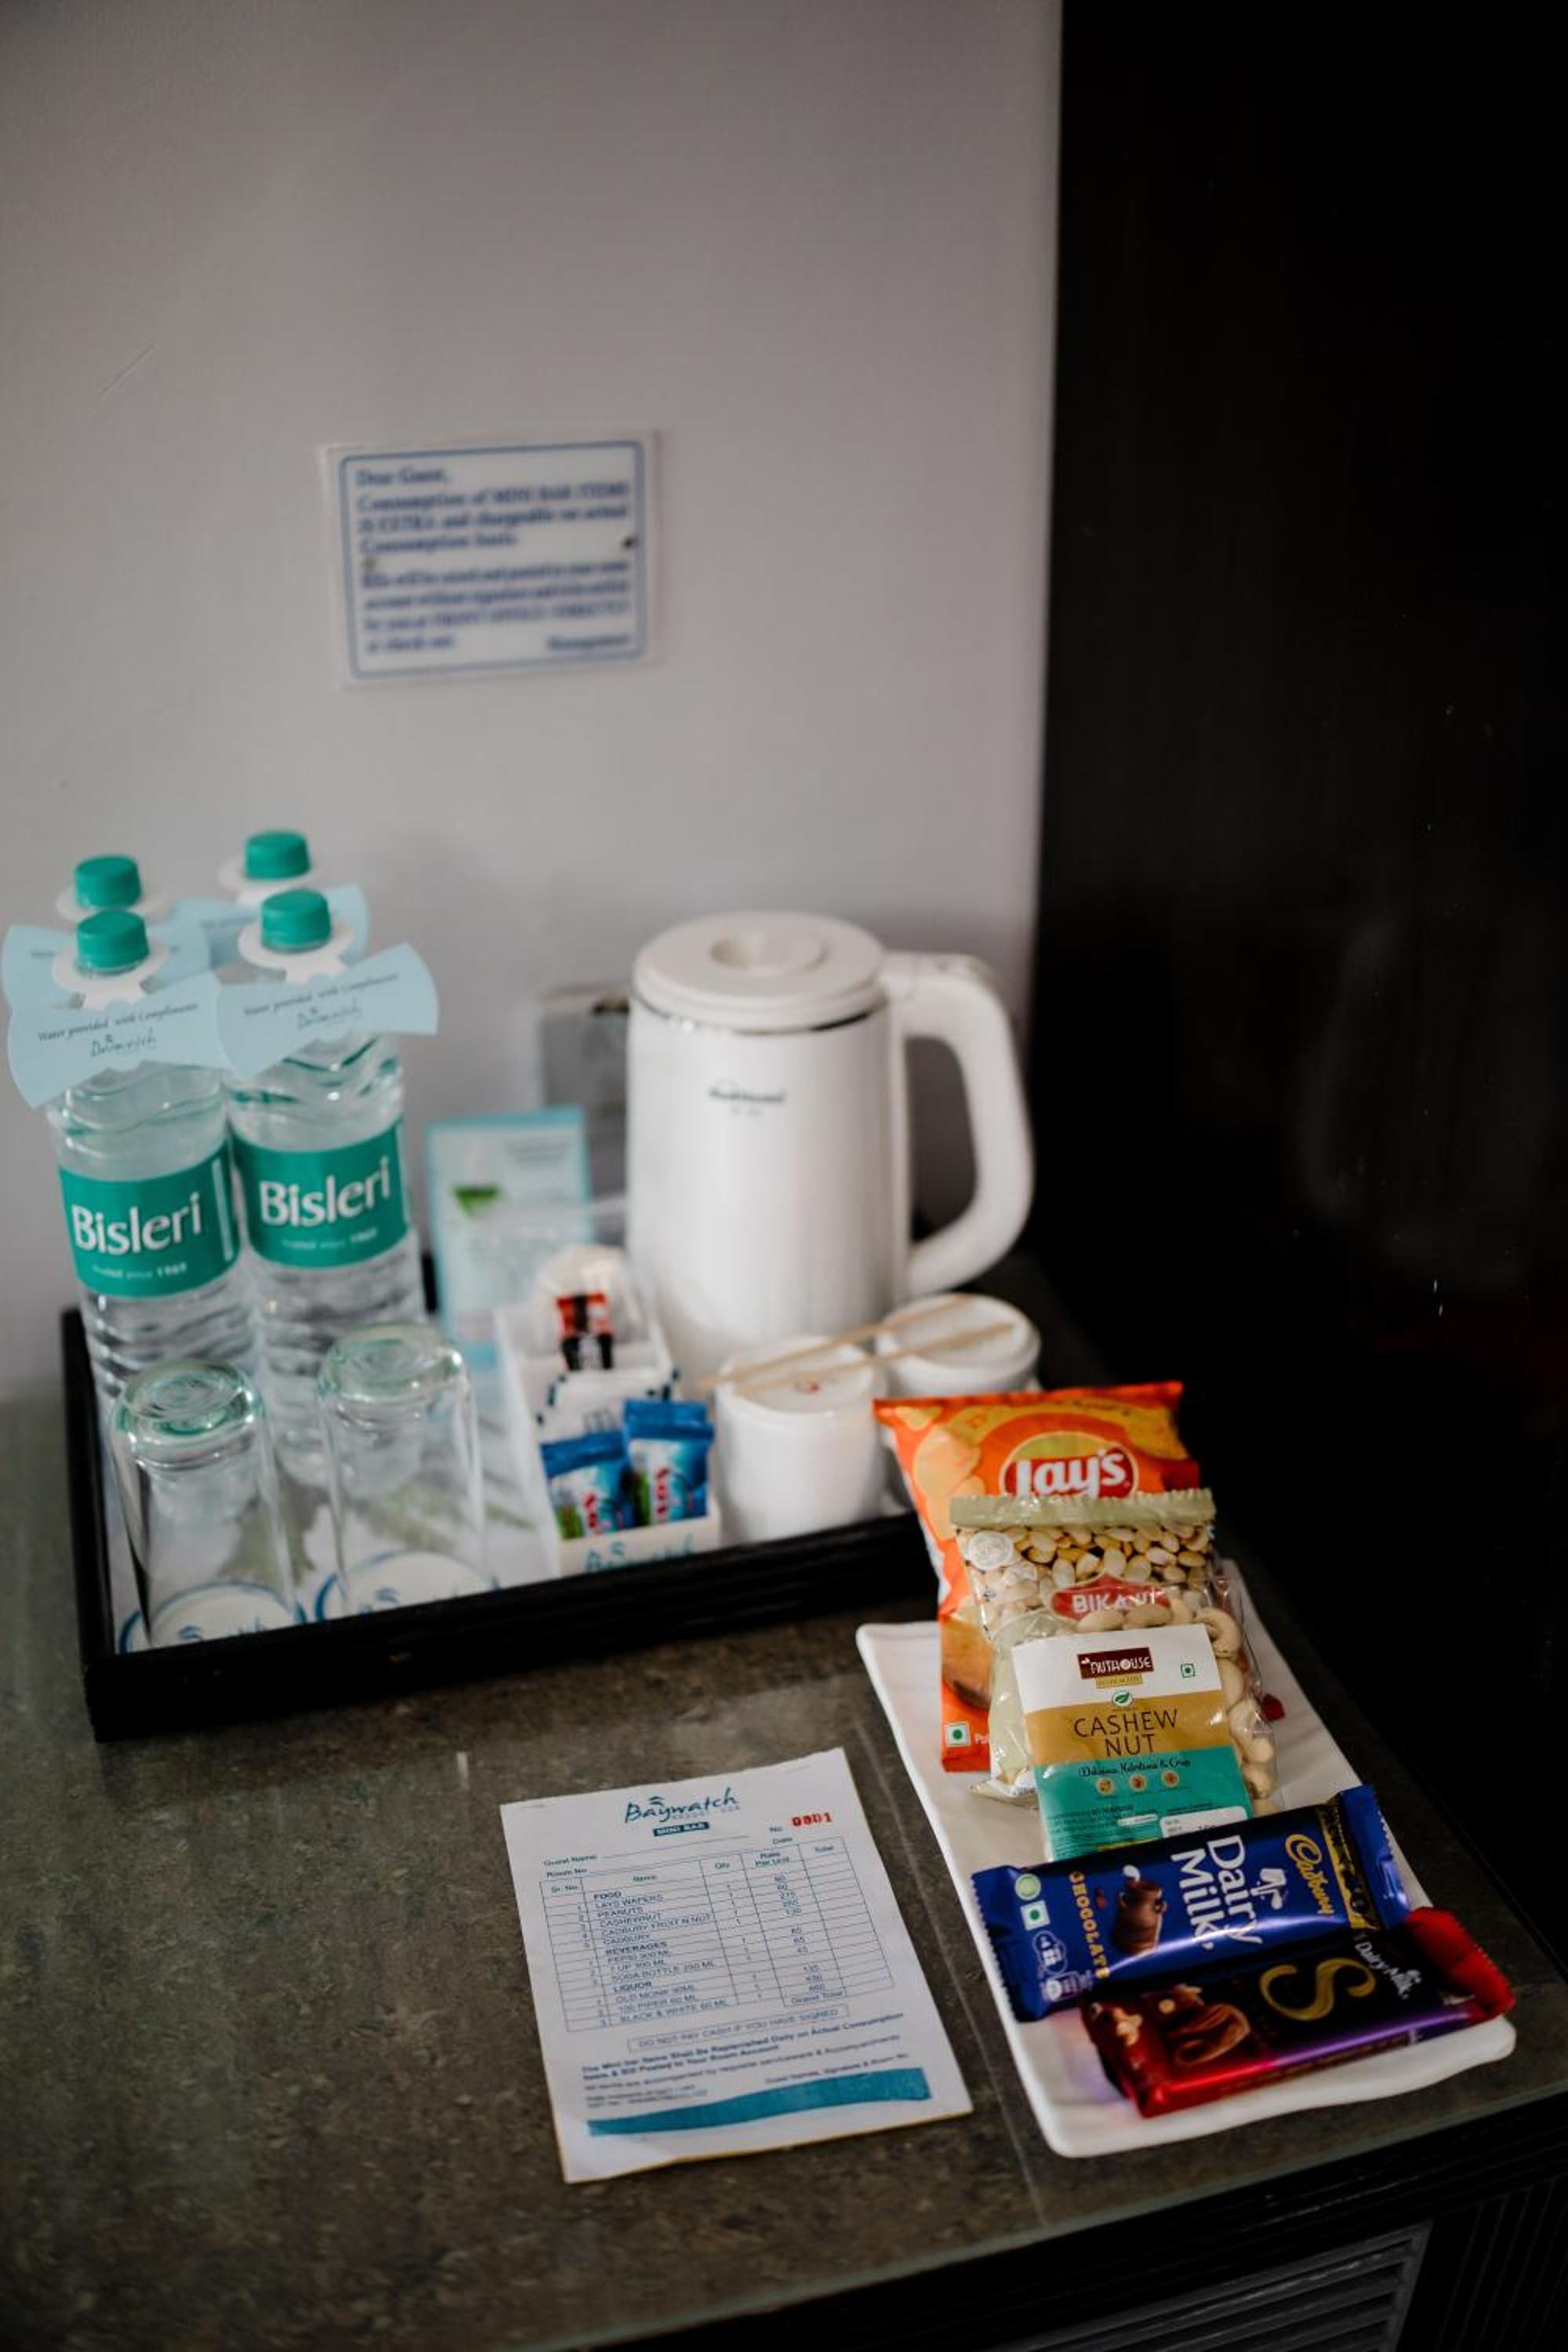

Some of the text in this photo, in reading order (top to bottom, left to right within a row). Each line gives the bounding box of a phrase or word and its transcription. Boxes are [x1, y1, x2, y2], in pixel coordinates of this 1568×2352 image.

[260, 1155, 390, 1227] Bisleri
[71, 1191, 201, 1255] Bisleri
[1073, 1708, 1178, 1738] CASHEW
[1104, 1733, 1155, 1757] NUT
[1284, 1833, 1335, 1915] Cadbury
[593, 1891, 622, 1900] FOOD
[1171, 1848, 1228, 1950] Milk
[1207, 1834, 1264, 1945] Dairy
[597, 1906, 644, 1918] PEANUTS
[600, 1912, 662, 1928] CASHEWNUT
[605, 1941, 667, 1956] BEVERAGES
[613, 1980, 652, 1993] LIQUOR
